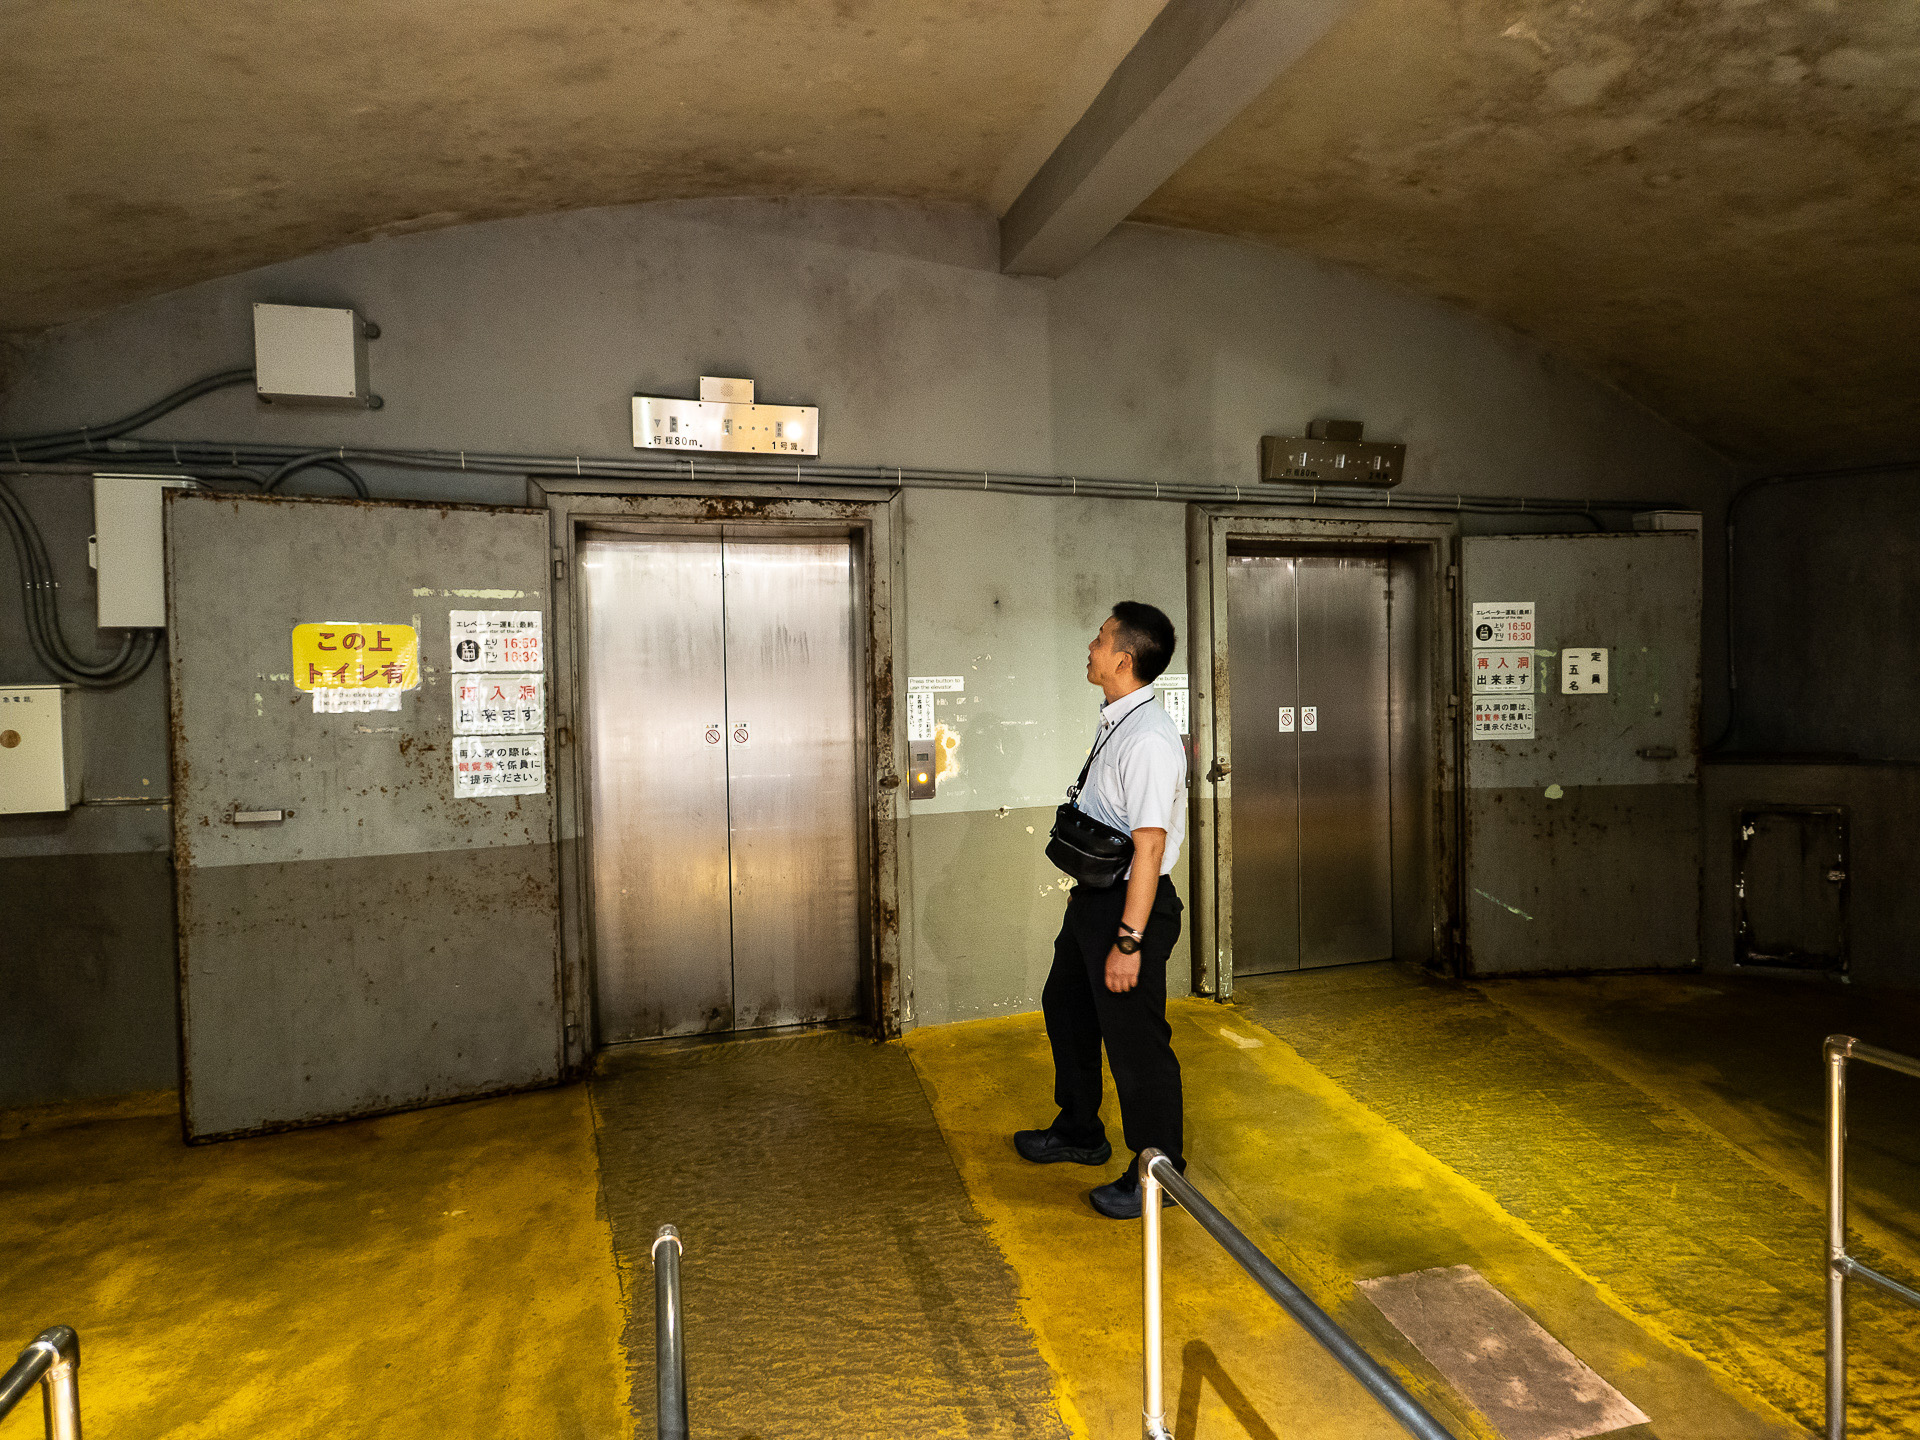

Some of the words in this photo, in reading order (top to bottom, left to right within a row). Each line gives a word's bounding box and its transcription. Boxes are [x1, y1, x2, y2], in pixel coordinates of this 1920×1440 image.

[1507, 621, 1532, 631] 16:50
[317, 630, 394, 652] この上
[503, 637, 538, 649] 16:50
[1507, 632, 1532, 641] 16:30
[1476, 656, 1530, 669] 再入洞
[1590, 651, 1602, 685] 定員
[309, 661, 407, 684] トイレ有
[1476, 673, 1530, 685] 出来ます
[1568, 654, 1580, 691] 一五名
